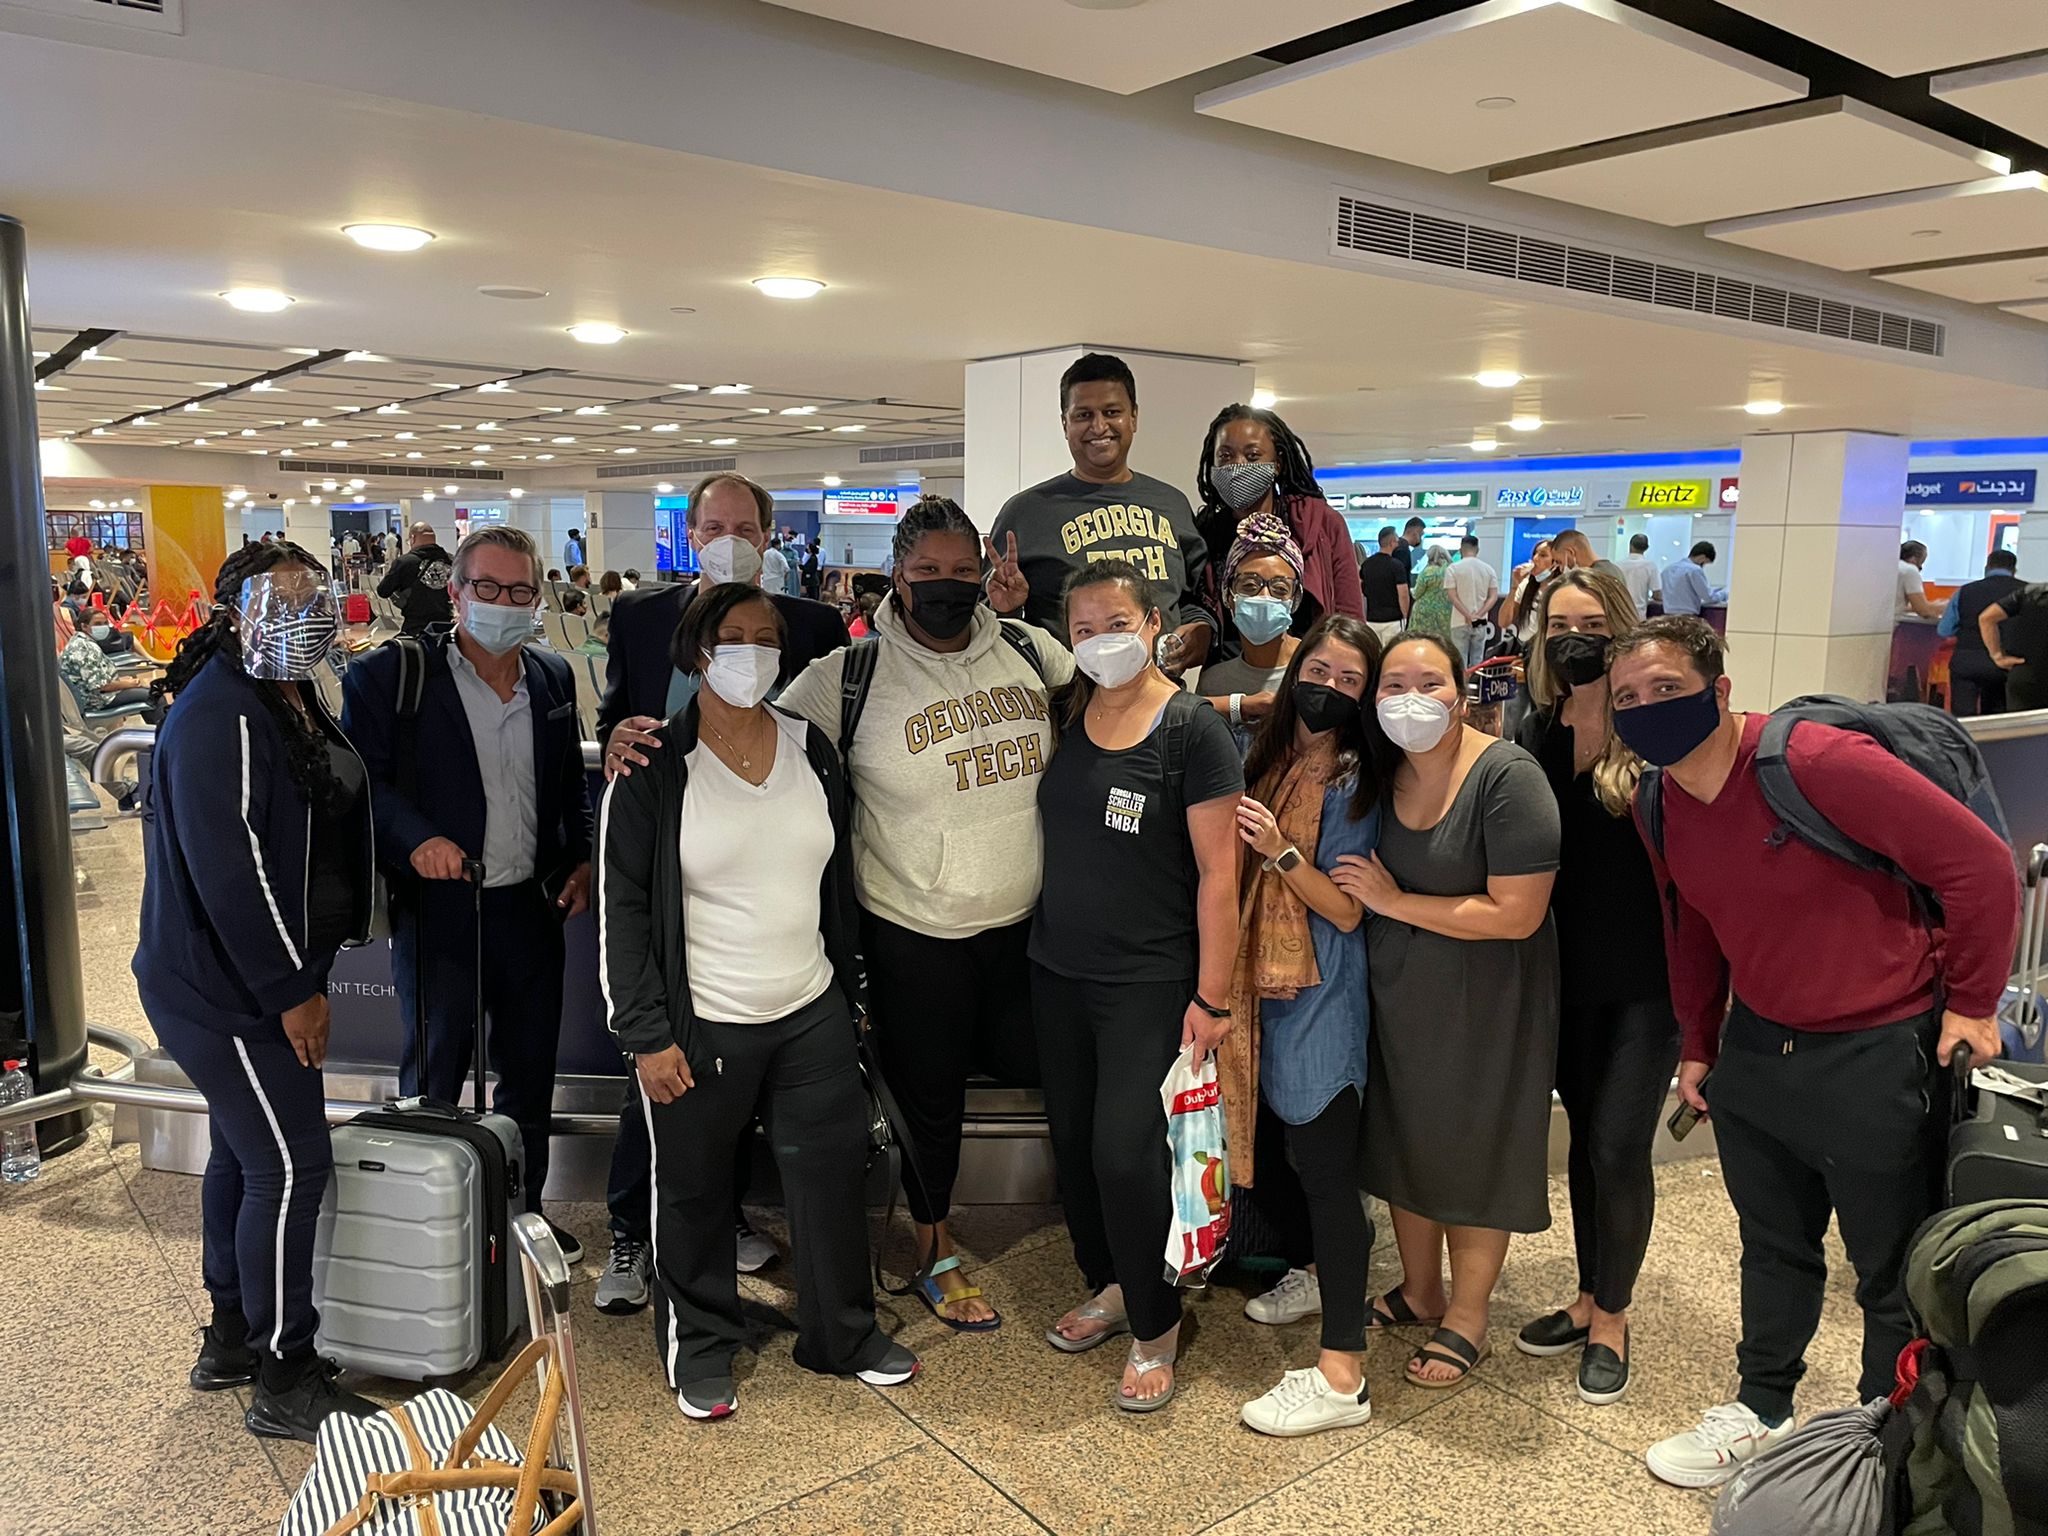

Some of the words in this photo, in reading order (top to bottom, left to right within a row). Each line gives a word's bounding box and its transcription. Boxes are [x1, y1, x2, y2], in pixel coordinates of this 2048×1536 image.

[1640, 485, 1695, 503] Hertz
[1906, 482, 1941, 498] udget
[1977, 480, 2025, 497] بدجت
[1061, 504, 1178, 555] GEORGIA
[904, 686, 1051, 755] GEORGIA
[945, 732, 1044, 792] TECH
[1107, 794, 1144, 813] SCHELLER
[1132, 792, 1147, 803] TECH
[1104, 810, 1140, 835] EMBA
